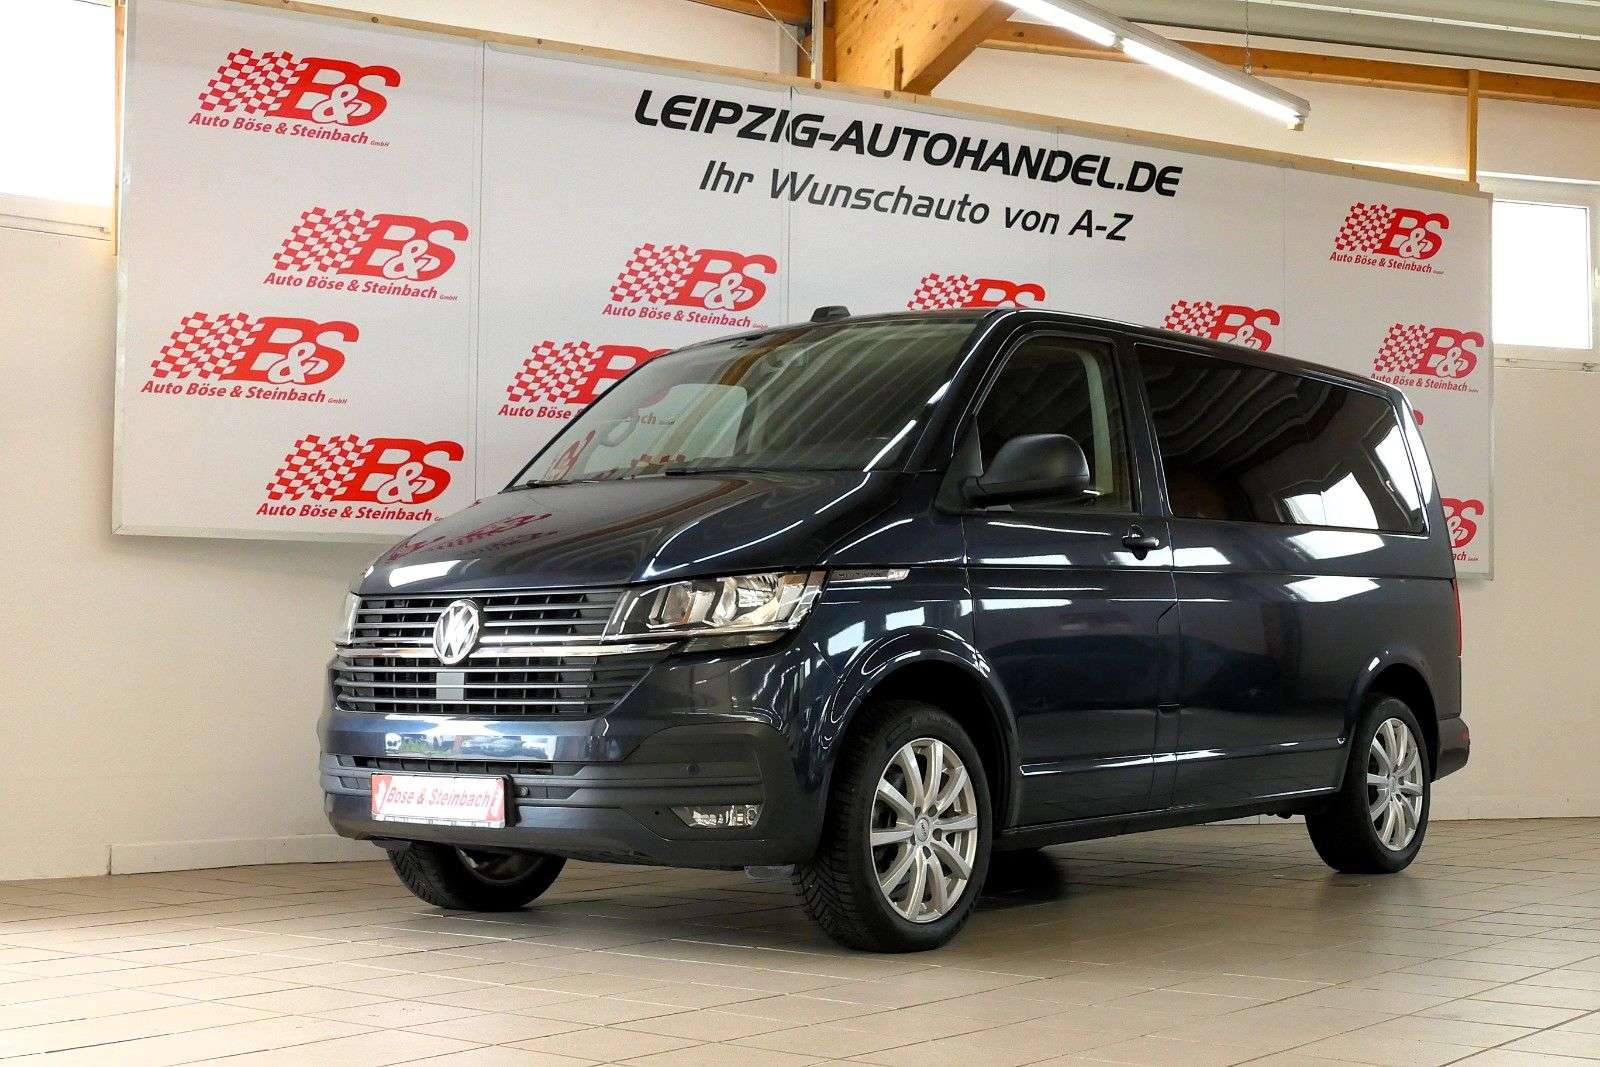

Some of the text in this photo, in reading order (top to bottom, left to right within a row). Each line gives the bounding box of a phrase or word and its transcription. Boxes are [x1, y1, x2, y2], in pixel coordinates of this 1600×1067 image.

[188, 112, 230, 128] Auto
[233, 117, 272, 133] Böse
[275, 122, 288, 135] &
[290, 124, 369, 144] Steinbach
[634, 89, 1184, 198] LEIPZIG-AUTOHANDEL.DE
[699, 160, 1135, 242] Ihr Wunschauto von A-Z
[1329, 251, 1432, 274] Auto Böse & Steinbach
[263, 272, 303, 287] Auto
[306, 275, 344, 291] Böse
[347, 279, 360, 292] &
[362, 280, 438, 299] Steinbach
[602, 303, 636, 316] Auto
[639, 306, 671, 320] Böse
[673, 310, 684, 321] &
[686, 311, 752, 328] Steinbach
[141, 380, 183, 394] Auto
[186, 382, 226, 397] Böse
[230, 385, 243, 398] &
[245, 385, 326, 403] Steinbach
[1393, 375, 1415, 387] Böse
[1416, 378, 1423, 388] &
[1424, 378, 1468, 392] Steinbach
[498, 404, 534, 417] Auto
[537, 405, 572, 419] Böse
[256, 503, 296, 516] Auto
[300, 504, 337, 518] Böse
[340, 506, 353, 519] &
[355, 506, 432, 522] Steinbach
